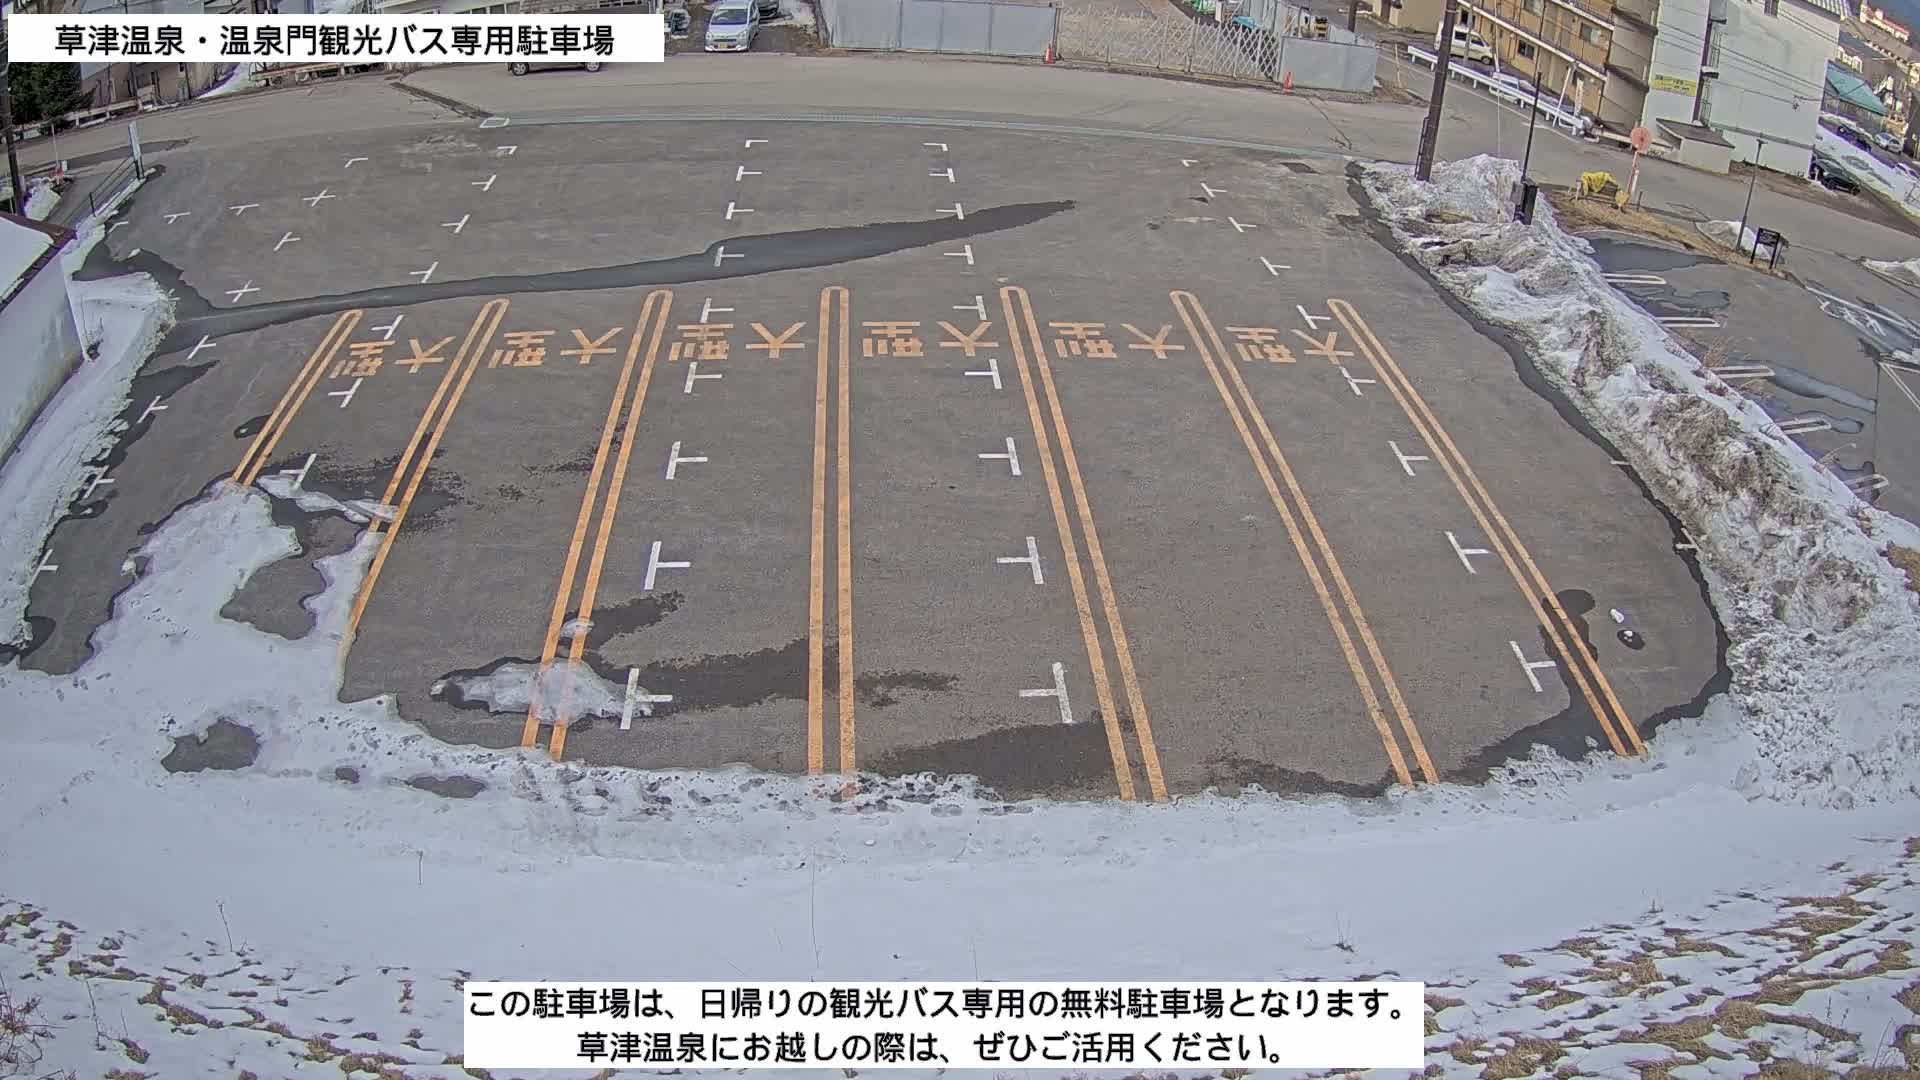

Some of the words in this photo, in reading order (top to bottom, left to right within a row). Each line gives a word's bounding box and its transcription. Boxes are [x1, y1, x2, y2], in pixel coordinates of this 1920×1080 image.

[330, 336, 456, 378] 大型
[489, 327, 623, 369] 大型
[669, 322, 806, 359] 大型
[861, 321, 1000, 357] 大型
[1048, 322, 1186, 360] 大型
[1226, 328, 1355, 364] 大型
